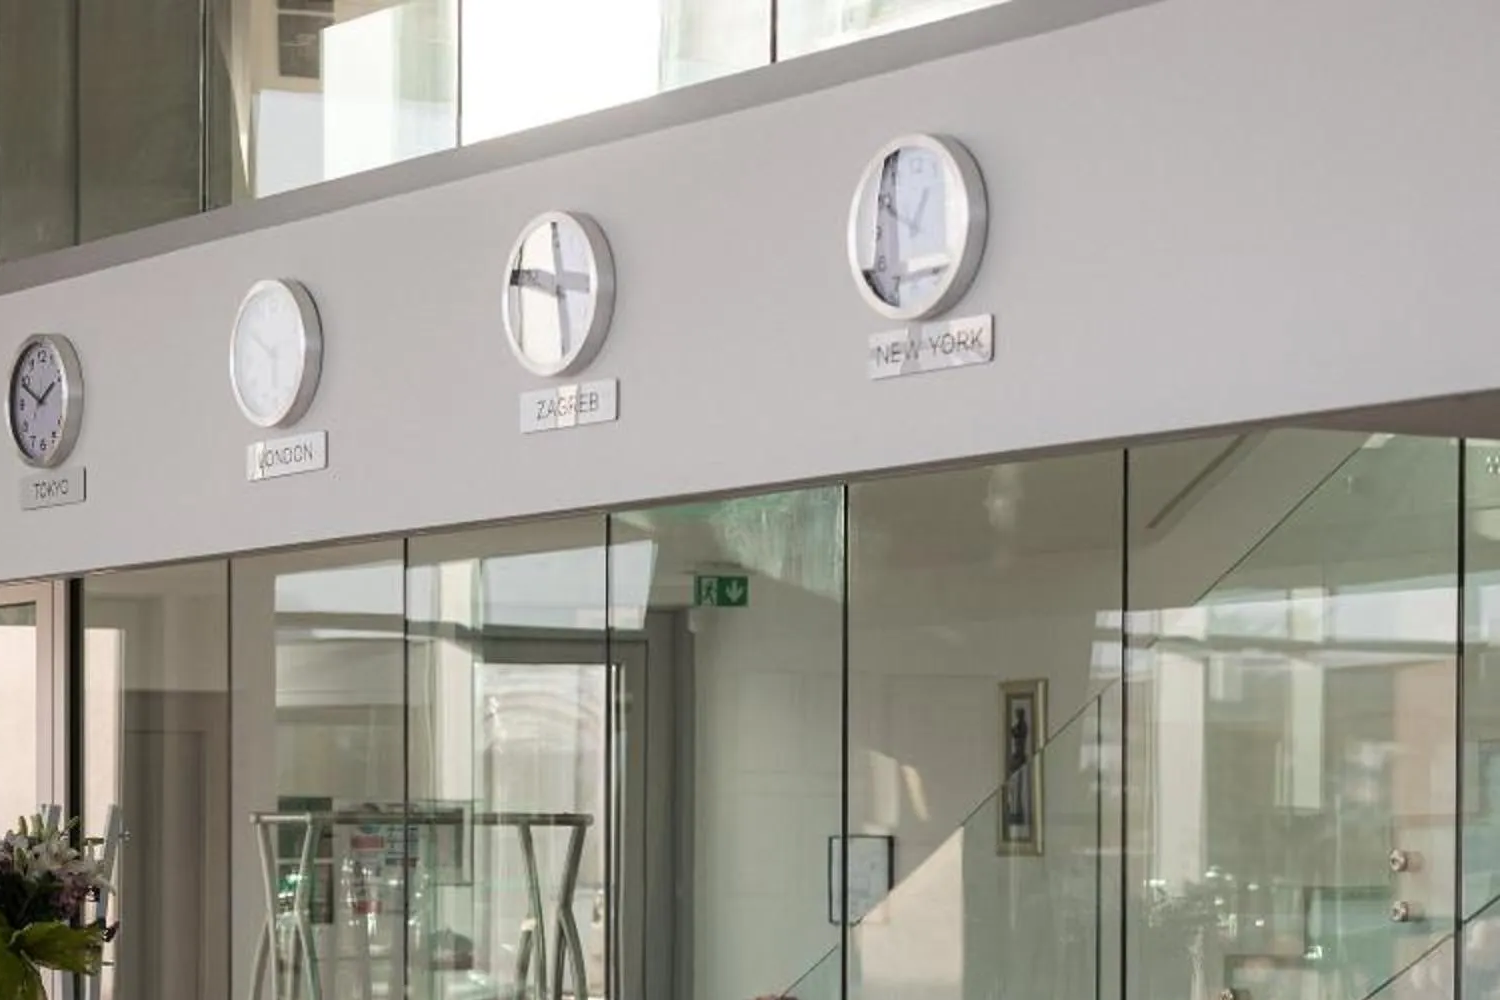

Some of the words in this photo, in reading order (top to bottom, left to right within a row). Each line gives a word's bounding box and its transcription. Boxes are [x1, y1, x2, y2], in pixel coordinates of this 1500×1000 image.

[876, 340, 919, 367] NEW
[928, 327, 985, 357] YORK
[536, 391, 599, 420] ZAGREB
[259, 441, 313, 468] LONDON
[34, 479, 69, 499] TOKYO
